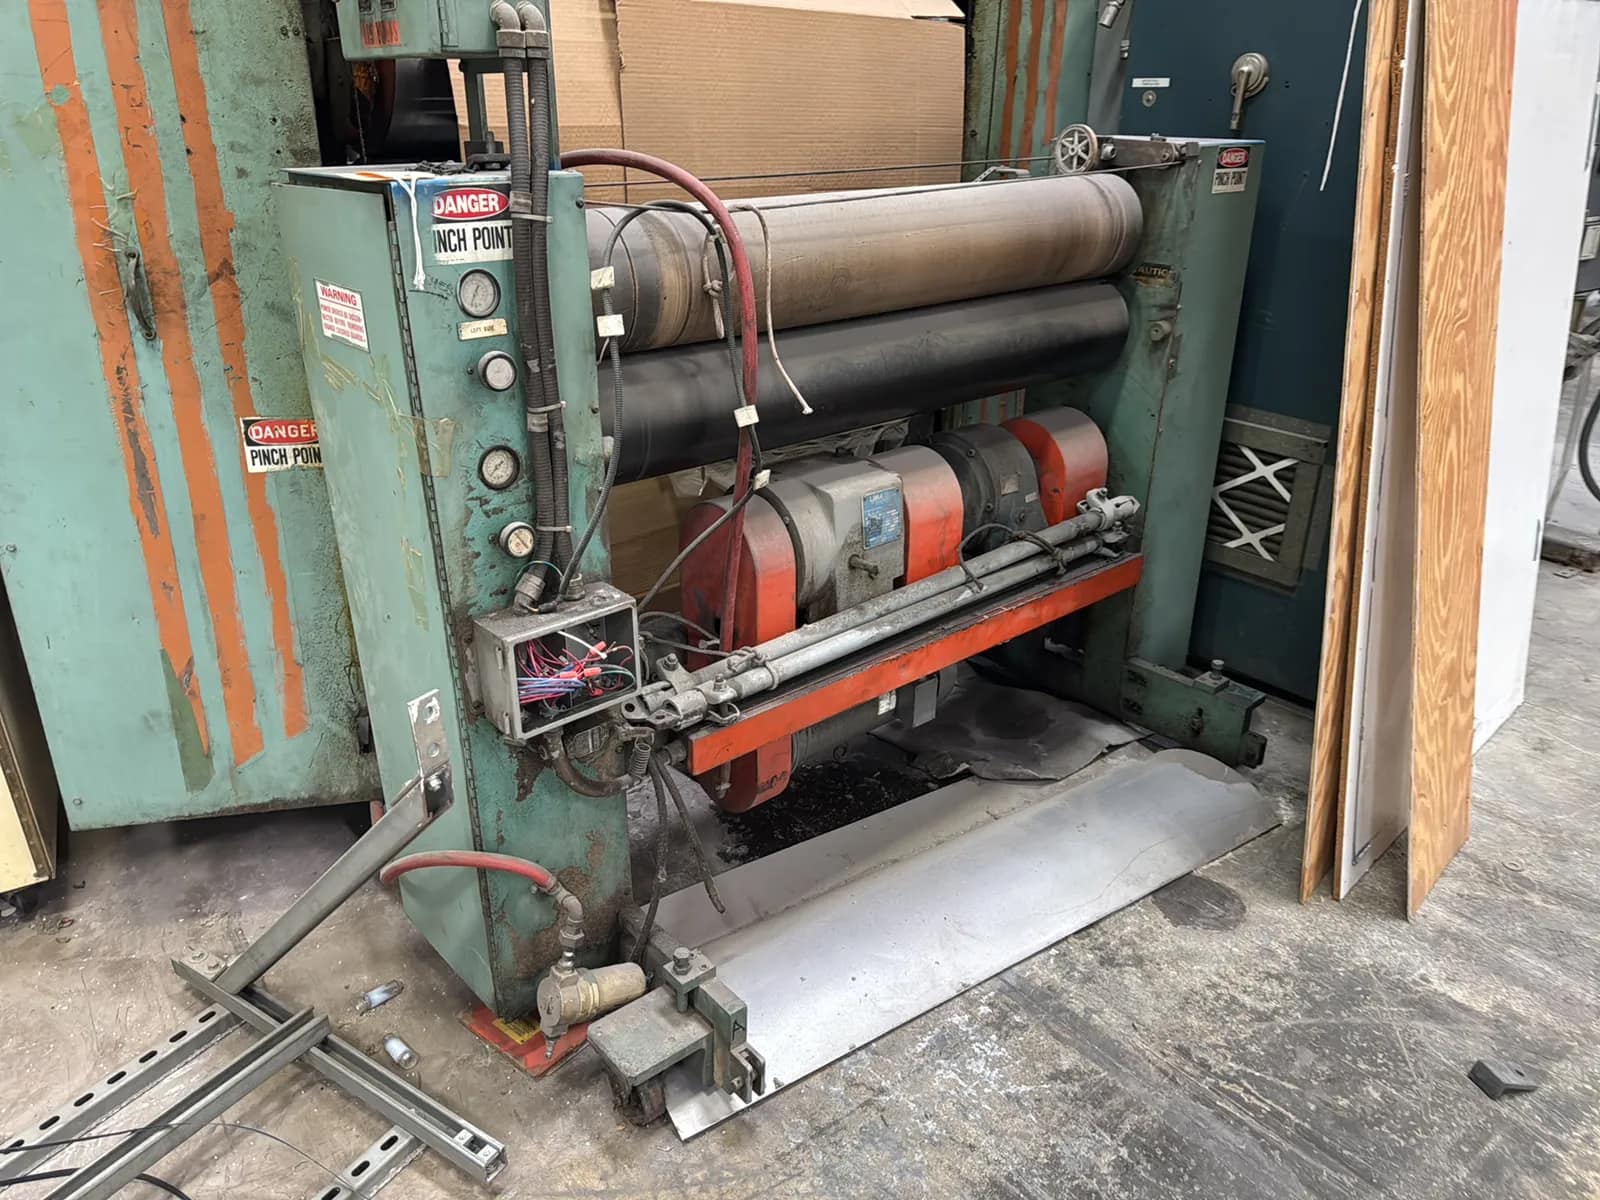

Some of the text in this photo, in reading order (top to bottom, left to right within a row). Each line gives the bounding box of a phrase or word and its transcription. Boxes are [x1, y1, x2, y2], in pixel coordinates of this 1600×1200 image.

[433, 193, 500, 215] DANGER
[433, 225, 513, 254] INCH POINT
[1137, 265, 1169, 277] AUTIO
[319, 285, 358, 307] WARNING
[250, 446, 322, 467] PINCH POIN
